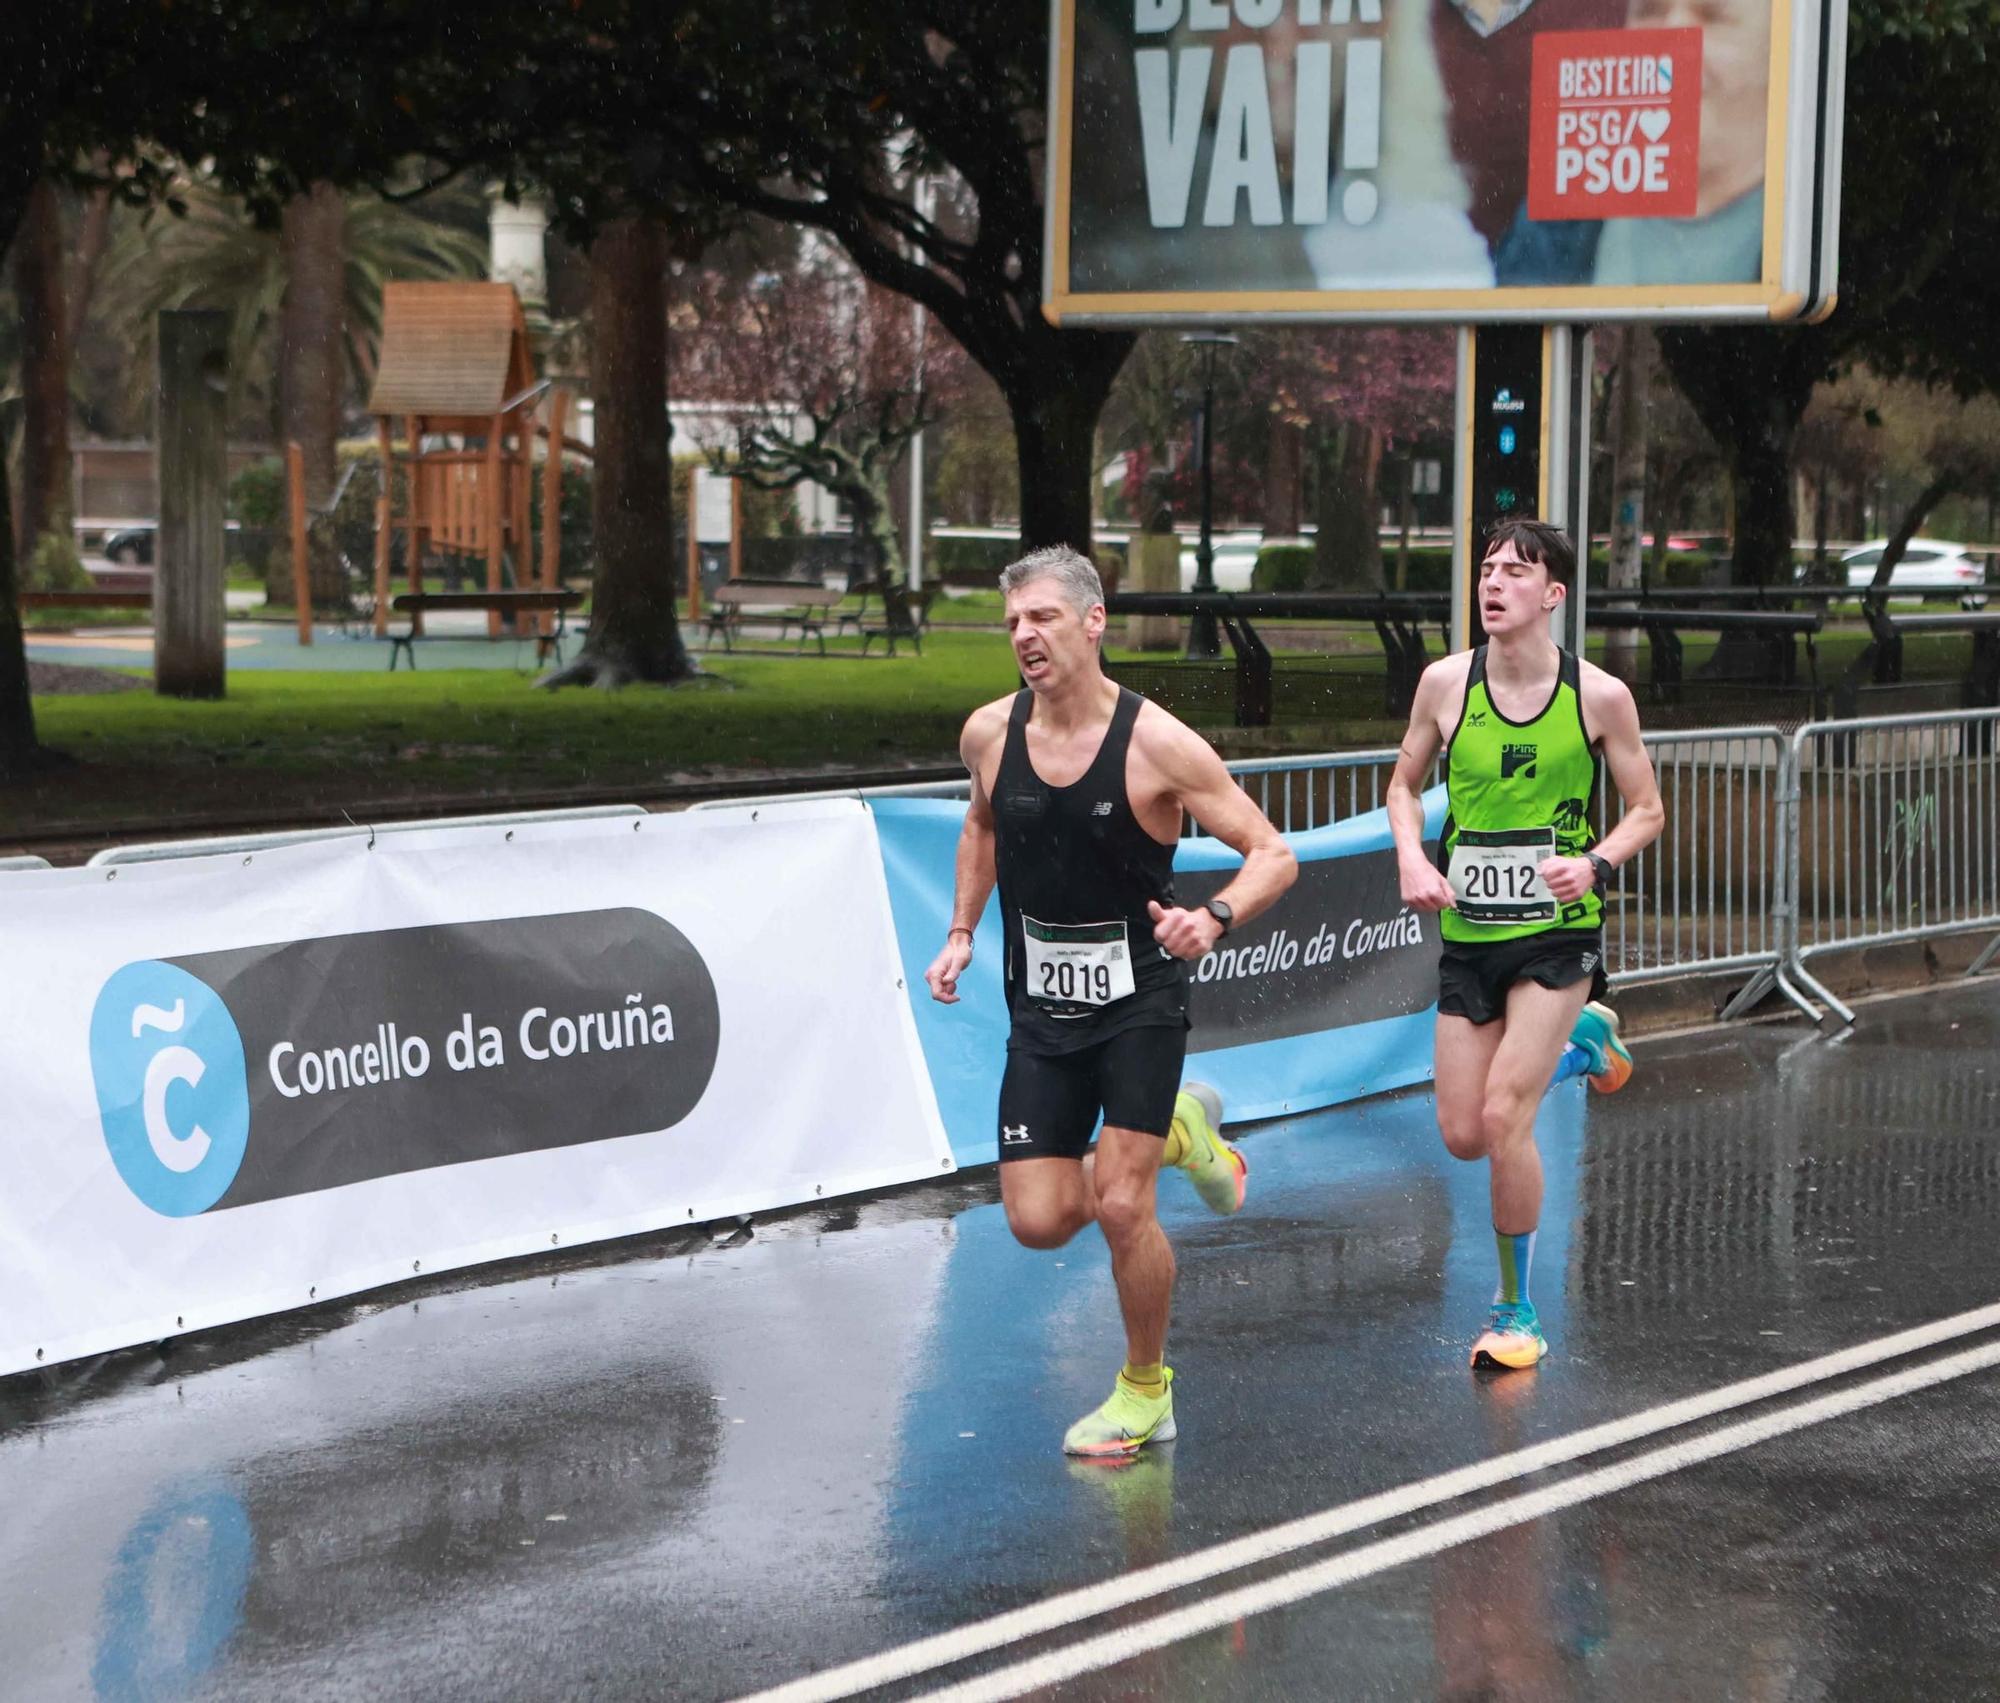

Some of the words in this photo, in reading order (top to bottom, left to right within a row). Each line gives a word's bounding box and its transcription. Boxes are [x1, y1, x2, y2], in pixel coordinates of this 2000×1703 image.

[1558, 54, 1673, 98] BESTEIRO
[1134, 38, 1383, 229] VAI!
[1556, 144, 1670, 195] PSOE
[1464, 865, 1536, 898] 2012
[1189, 930, 1299, 984] oncello
[1303, 923, 1336, 967] da
[1342, 906, 1423, 960] Coruña
[1040, 961, 1112, 1001] 2019
[268, 1022, 431, 1099] Concello
[446, 1013, 504, 1071] da
[519, 992, 675, 1060] Coruña
